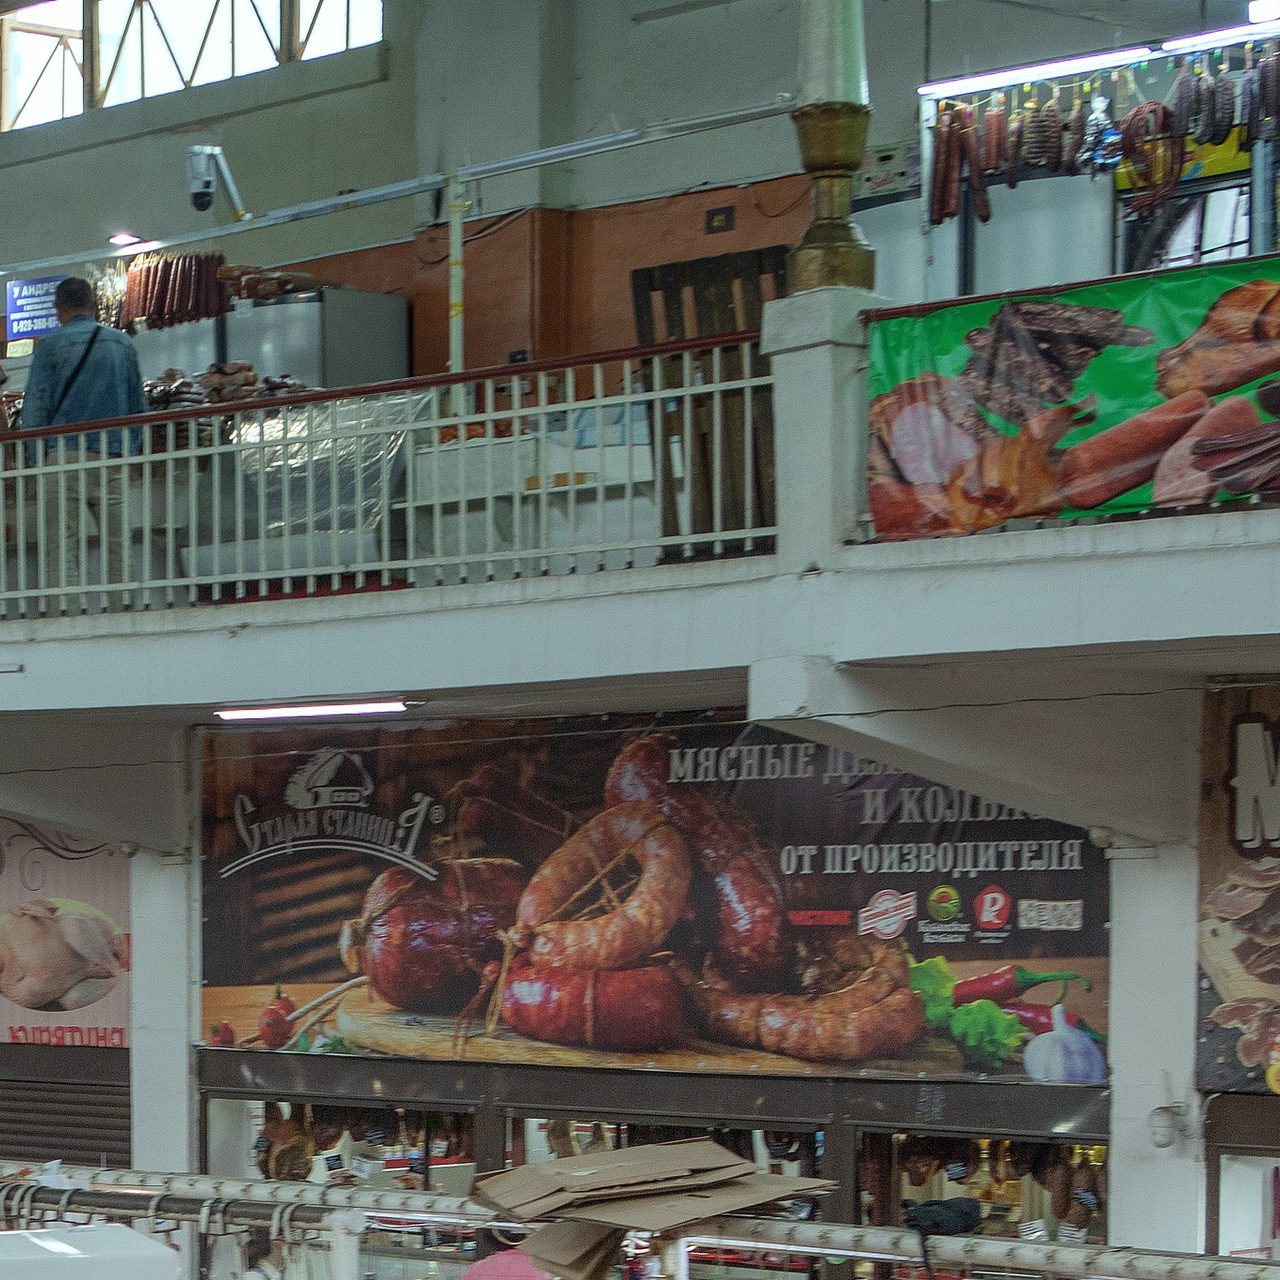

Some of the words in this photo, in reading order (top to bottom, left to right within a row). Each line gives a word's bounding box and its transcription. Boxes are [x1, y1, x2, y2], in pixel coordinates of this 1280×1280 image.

[13, 286, 20, 298] У
[21, 281, 60, 297] АНДРЕ
[667, 743, 816, 784] МЯСНЫЕ
[861, 789, 889, 825] И
[779, 845, 818, 875] ОТ
[822, 840, 1085, 878] ПРОИЗВОДИТЕЛЯ
